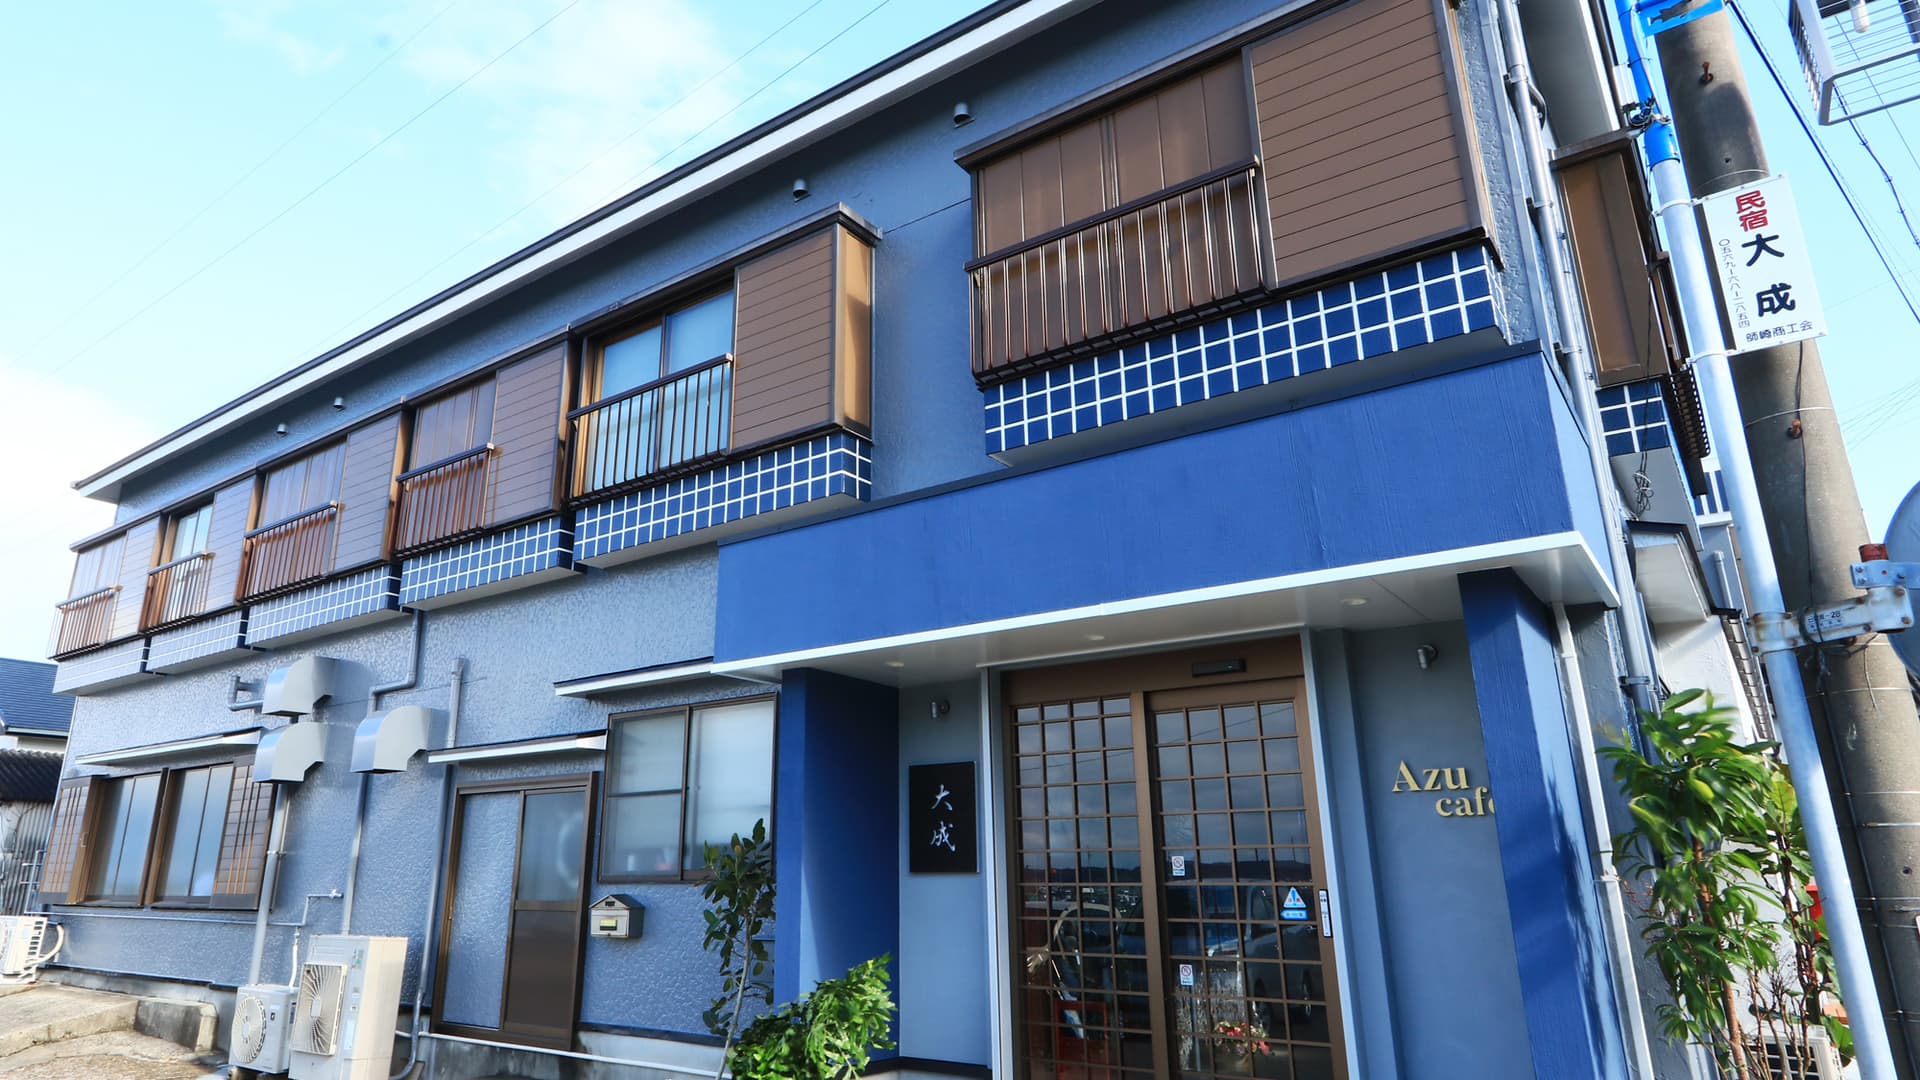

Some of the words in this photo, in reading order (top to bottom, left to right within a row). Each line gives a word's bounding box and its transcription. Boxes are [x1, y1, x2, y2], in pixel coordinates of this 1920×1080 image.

[1735, 190, 1768, 232] 民宿
[1741, 233, 1796, 318] 大成
[1392, 759, 1470, 792] Azu
[930, 784, 956, 852] 大成
